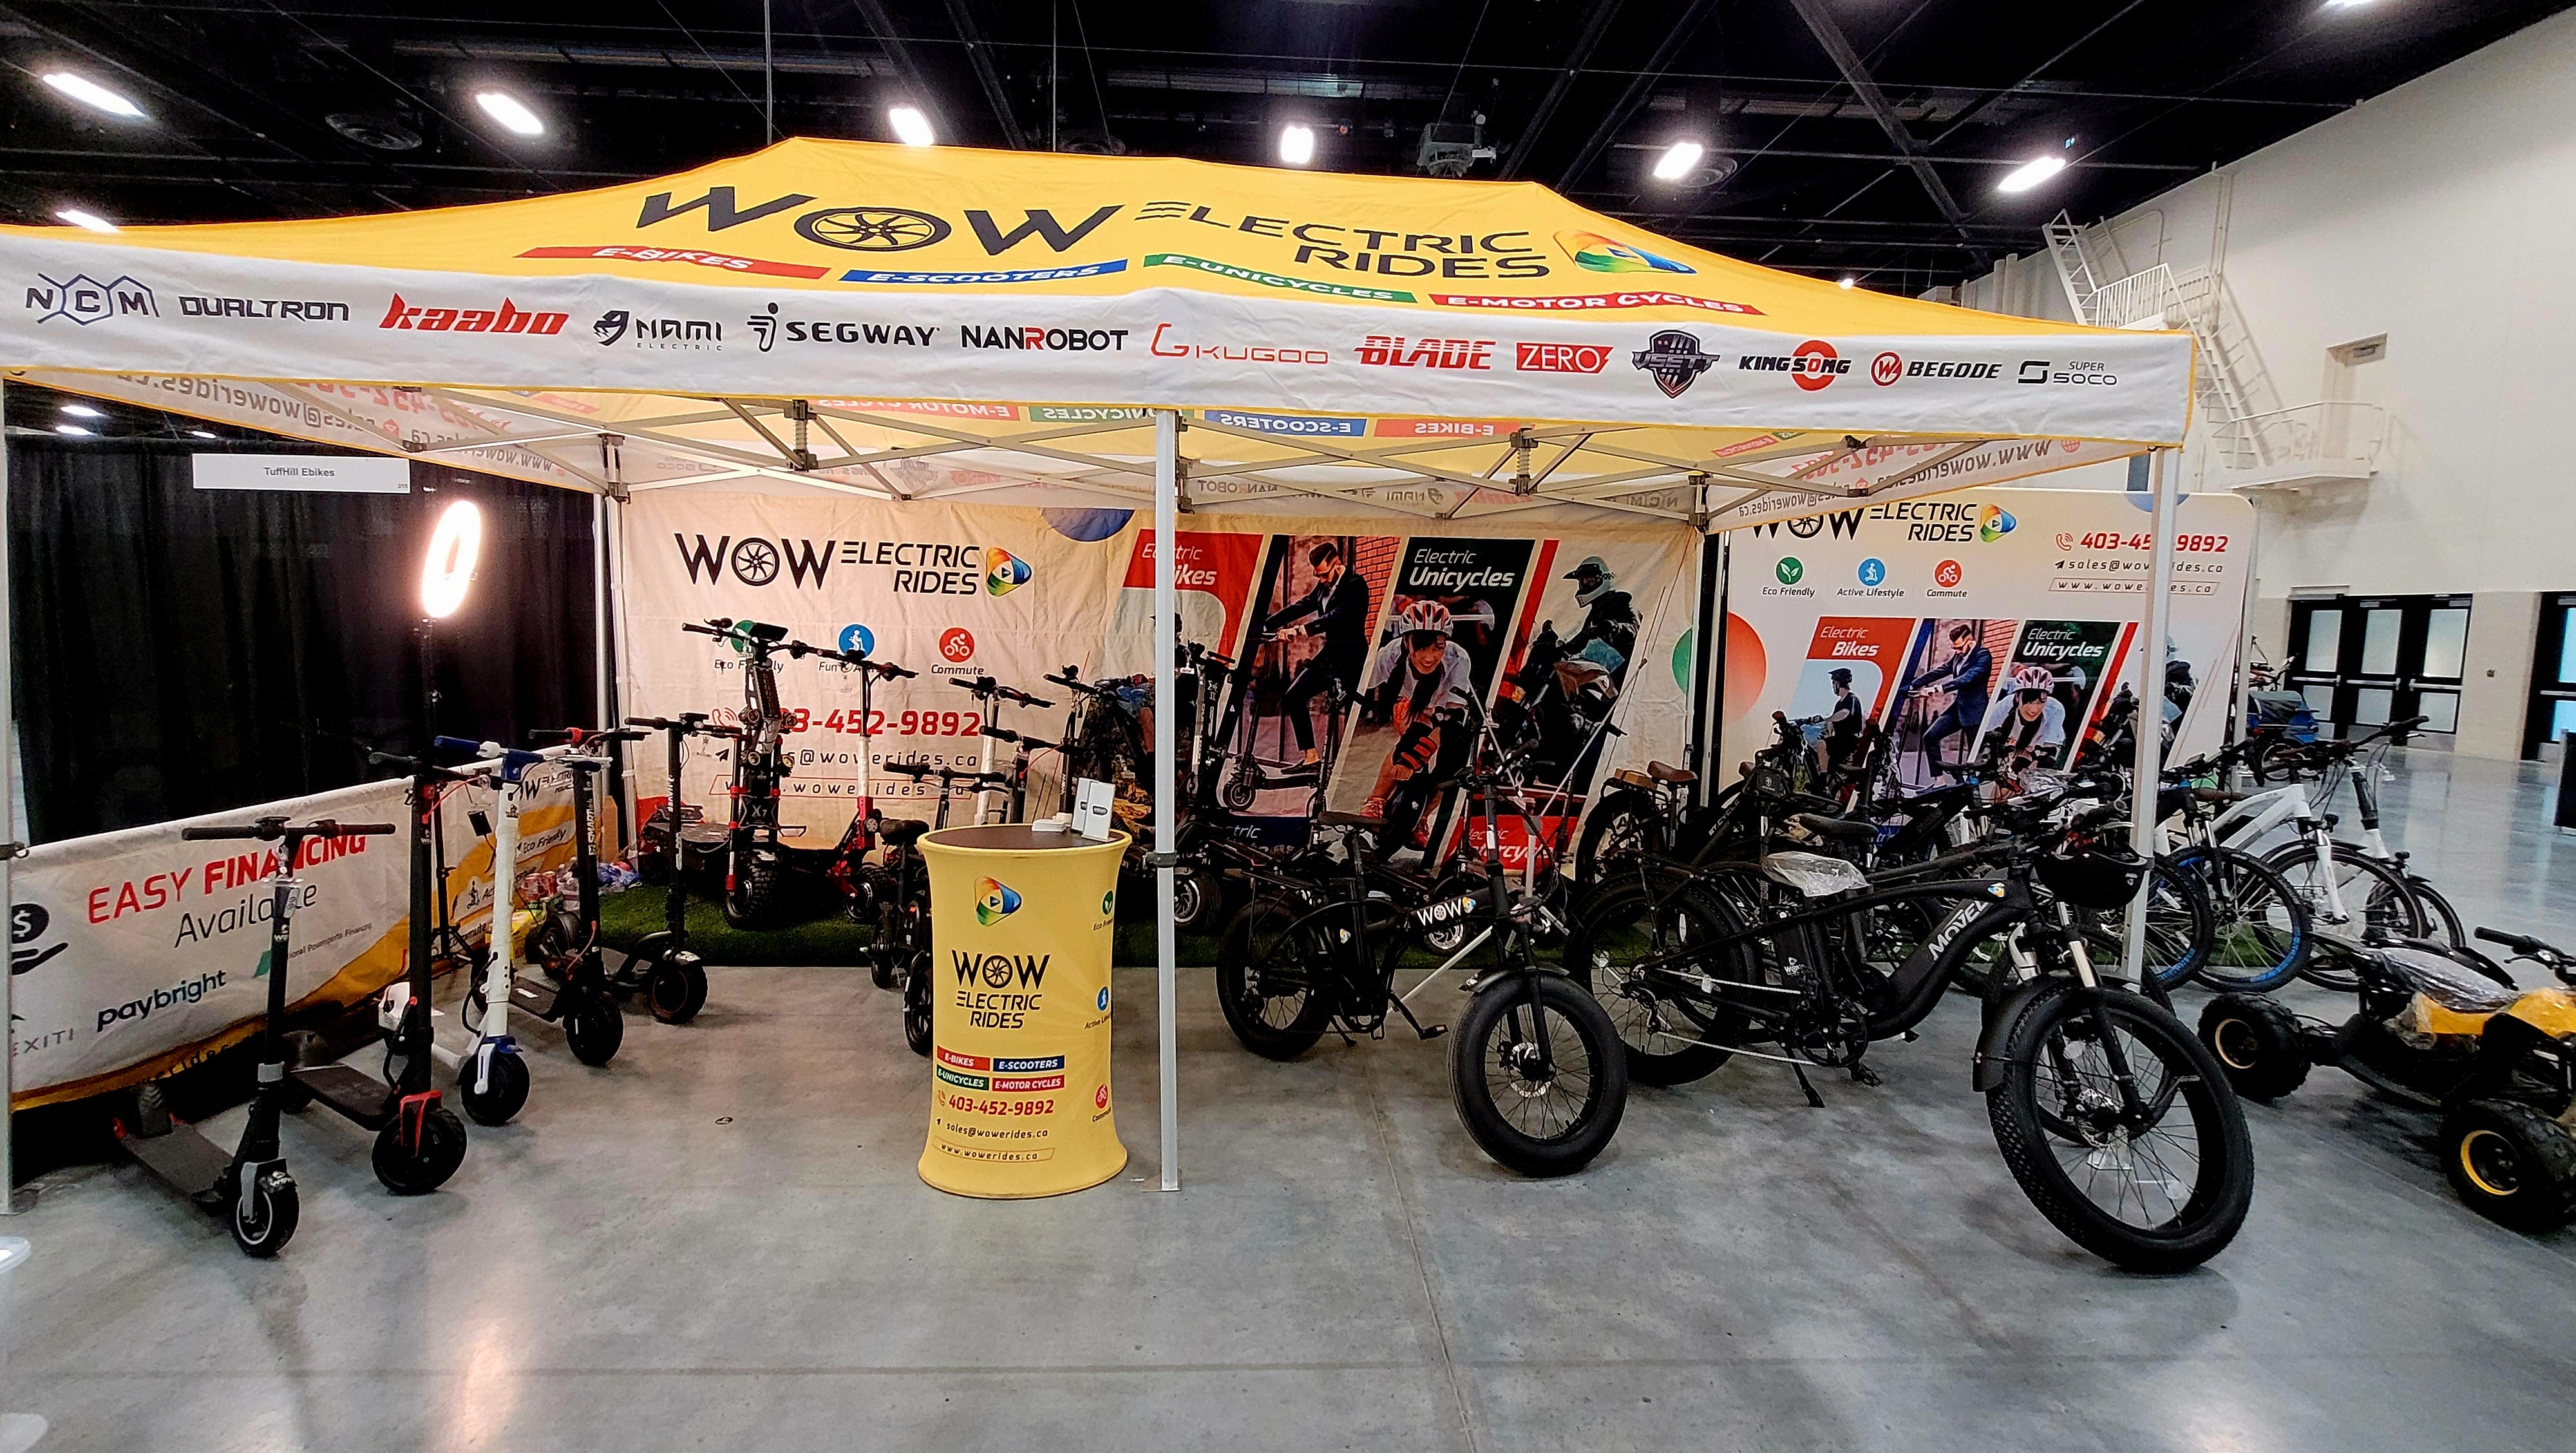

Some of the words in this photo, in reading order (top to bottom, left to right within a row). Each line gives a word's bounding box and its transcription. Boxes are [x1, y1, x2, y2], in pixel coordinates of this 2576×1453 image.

[636, 186, 1124, 255] WOW
[1135, 200, 1533, 254] ELECTRIC
[591, 246, 755, 271] E-BIKES
[1294, 244, 1550, 278] RIDES
[865, 265, 1101, 283] E-SCOOTERS
[1160, 254, 1396, 301] E-UNICYCLES
[178, 295, 350, 322] DUALTRON
[1446, 293, 1607, 309] E-MOTOR
[1616, 292, 1747, 314] CYCLES
[379, 292, 569, 336] kaabo
[636, 318, 723, 342] NAMI
[786, 320, 935, 347] SEGWAY
[960, 324, 1129, 352] NANROBOT
[637, 342, 723, 352] ELECTRIC
[1196, 345, 1329, 365] KUGOO
[1354, 334, 1495, 370] BLADE
[1520, 345, 1603, 374] ZERO
[1739, 354, 1852, 375] KINGSONG
[1906, 359, 2002, 380] BEGODE
[2068, 360, 2105, 372] SUPER
[2052, 372, 2118, 386] SOCO
[264, 466, 299, 477] TuffHill
[301, 467, 336, 478] Ebikes
[1869, 502, 1977, 522] ELECTRIC
[1908, 523, 1976, 542] RIDES
[2079, 532, 2229, 553] 403-459892
[1142, 542, 1203, 560] Etric
[1414, 548, 1477, 565] Electric
[674, 533, 837, 591] WOW
[840, 541, 980, 569] ELECTRIC
[2068, 558, 2224, 573] sales@wowides.ca
[893, 570, 980, 596] RIDES
[1175, 564, 1217, 585] ikes
[1408, 566, 1516, 591] Unicycles
[1762, 587, 1777, 596] Eco
[1779, 587, 1816, 598] Friendly
[1837, 588, 1864, 596] Active
[1866, 588, 1905, 598] Lifestyle
[1926, 589, 1968, 598] Commute
[2058, 581, 2211, 593] www.wowees.ca
[1819, 625, 1869, 640] Electric
[2028, 627, 2076, 641] Electric
[1831, 641, 1879, 658] Bikes
[2022, 642, 2103, 661] Unicycles
[819, 661, 837, 672] Fun
[931, 664, 985, 676] Commute
[781, 708, 981, 737] 3-452-9892
[88, 867, 193, 924] EASY
[174, 883, 317, 949] Availae
[1417, 899, 1462, 926] WOW
[951, 949, 1050, 990] WOW
[97, 969, 228, 1032] paybright
[956, 991, 1042, 1011] ELECTRIC
[970, 1011, 1025, 1029] RIDES
[944, 1052, 974, 1067] E-BIKES
[999, 1059, 1058, 1070] E-SCOOTERS
[938, 1068, 984, 1088] E-UNICYCLES
[995, 1080, 1030, 1090] E-MOTOR
[1030, 1078, 1061, 1088] CYCLES
[948, 1094, 1054, 1117] 403-452-9892
[946, 1121, 1048, 1139] sales@wowerides.ca
[940, 1142, 1038, 1161] www.wowerides.ca
